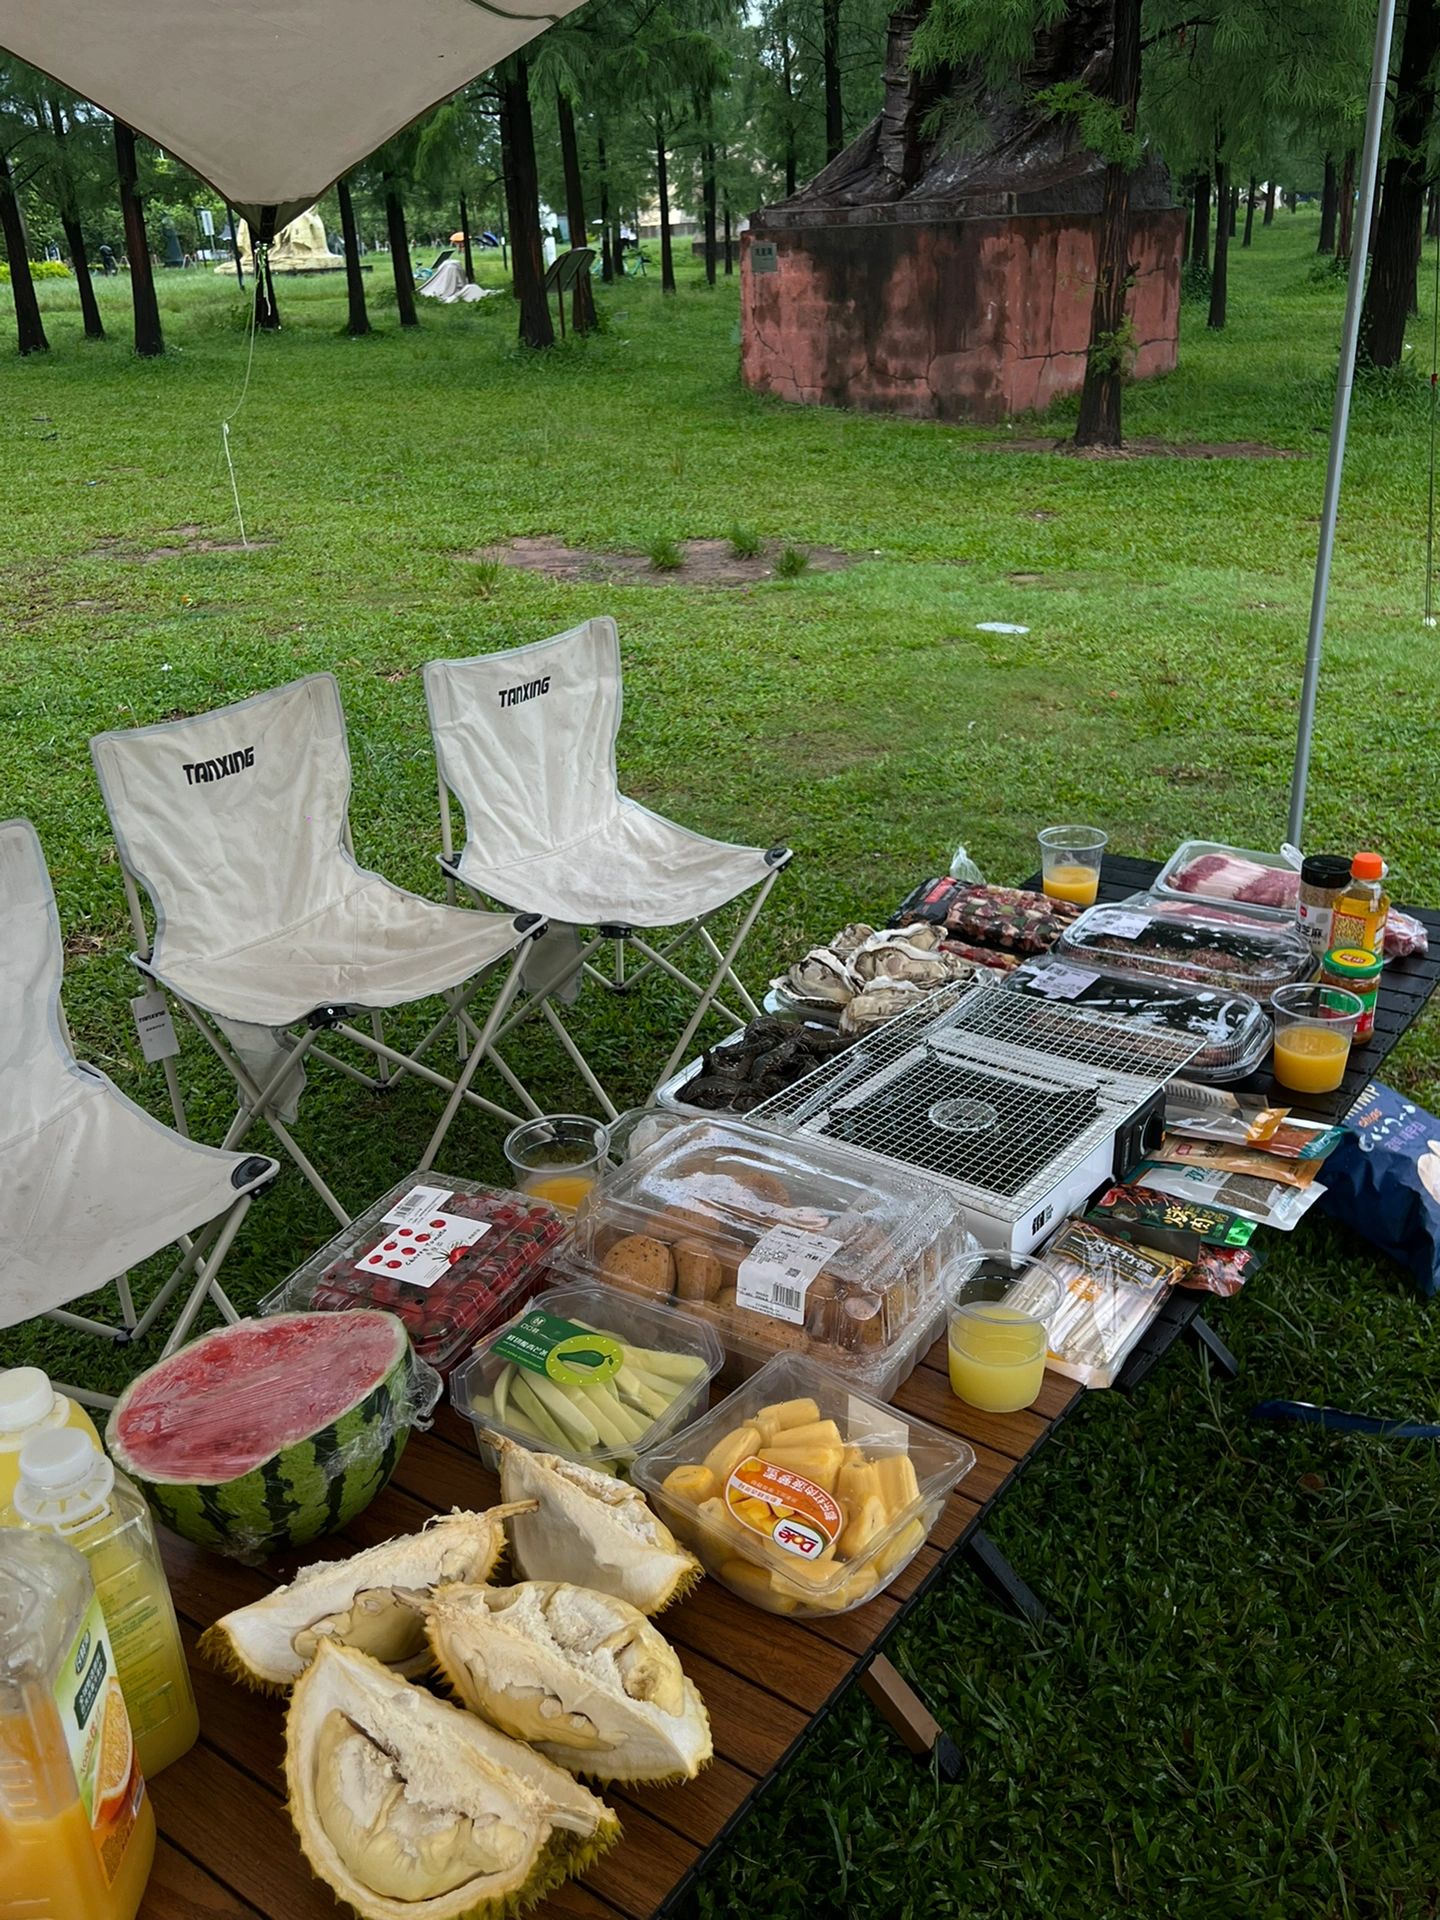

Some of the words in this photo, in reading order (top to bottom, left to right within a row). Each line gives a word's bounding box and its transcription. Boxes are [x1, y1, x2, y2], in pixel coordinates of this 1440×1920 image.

[498, 676, 551, 707] TANXING
[182, 746, 255, 785] TANXING
[762, 1465, 838, 1521] 都乐红肉菠萝蜜
[778, 1527, 817, 1554] Dole
